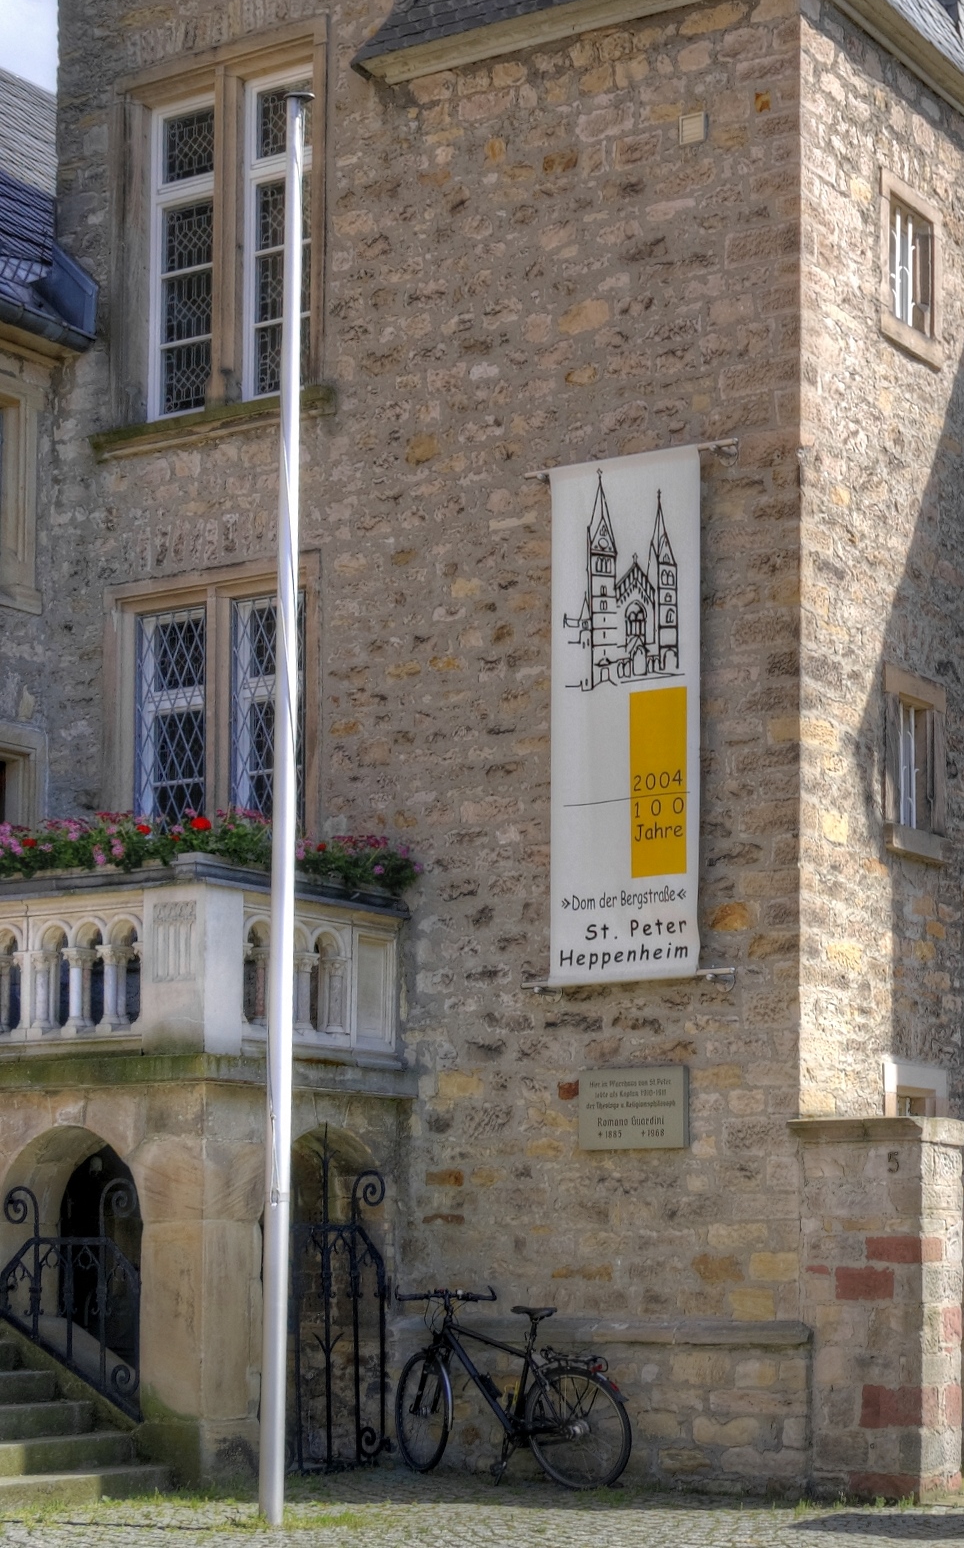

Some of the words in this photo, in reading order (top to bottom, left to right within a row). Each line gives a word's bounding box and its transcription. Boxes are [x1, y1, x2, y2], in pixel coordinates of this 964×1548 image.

[633, 768, 683, 792] 2004
[634, 821, 683, 842] Jahre
[599, 892, 618, 909] der
[584, 923, 618, 941] St.
[630, 918, 687, 937] Peter
[559, 942, 688, 970] Heppenheim
[597, 1116, 629, 1127] Romano
[631, 1115, 665, 1126] Guardini
[887, 1151, 900, 1173] 5
